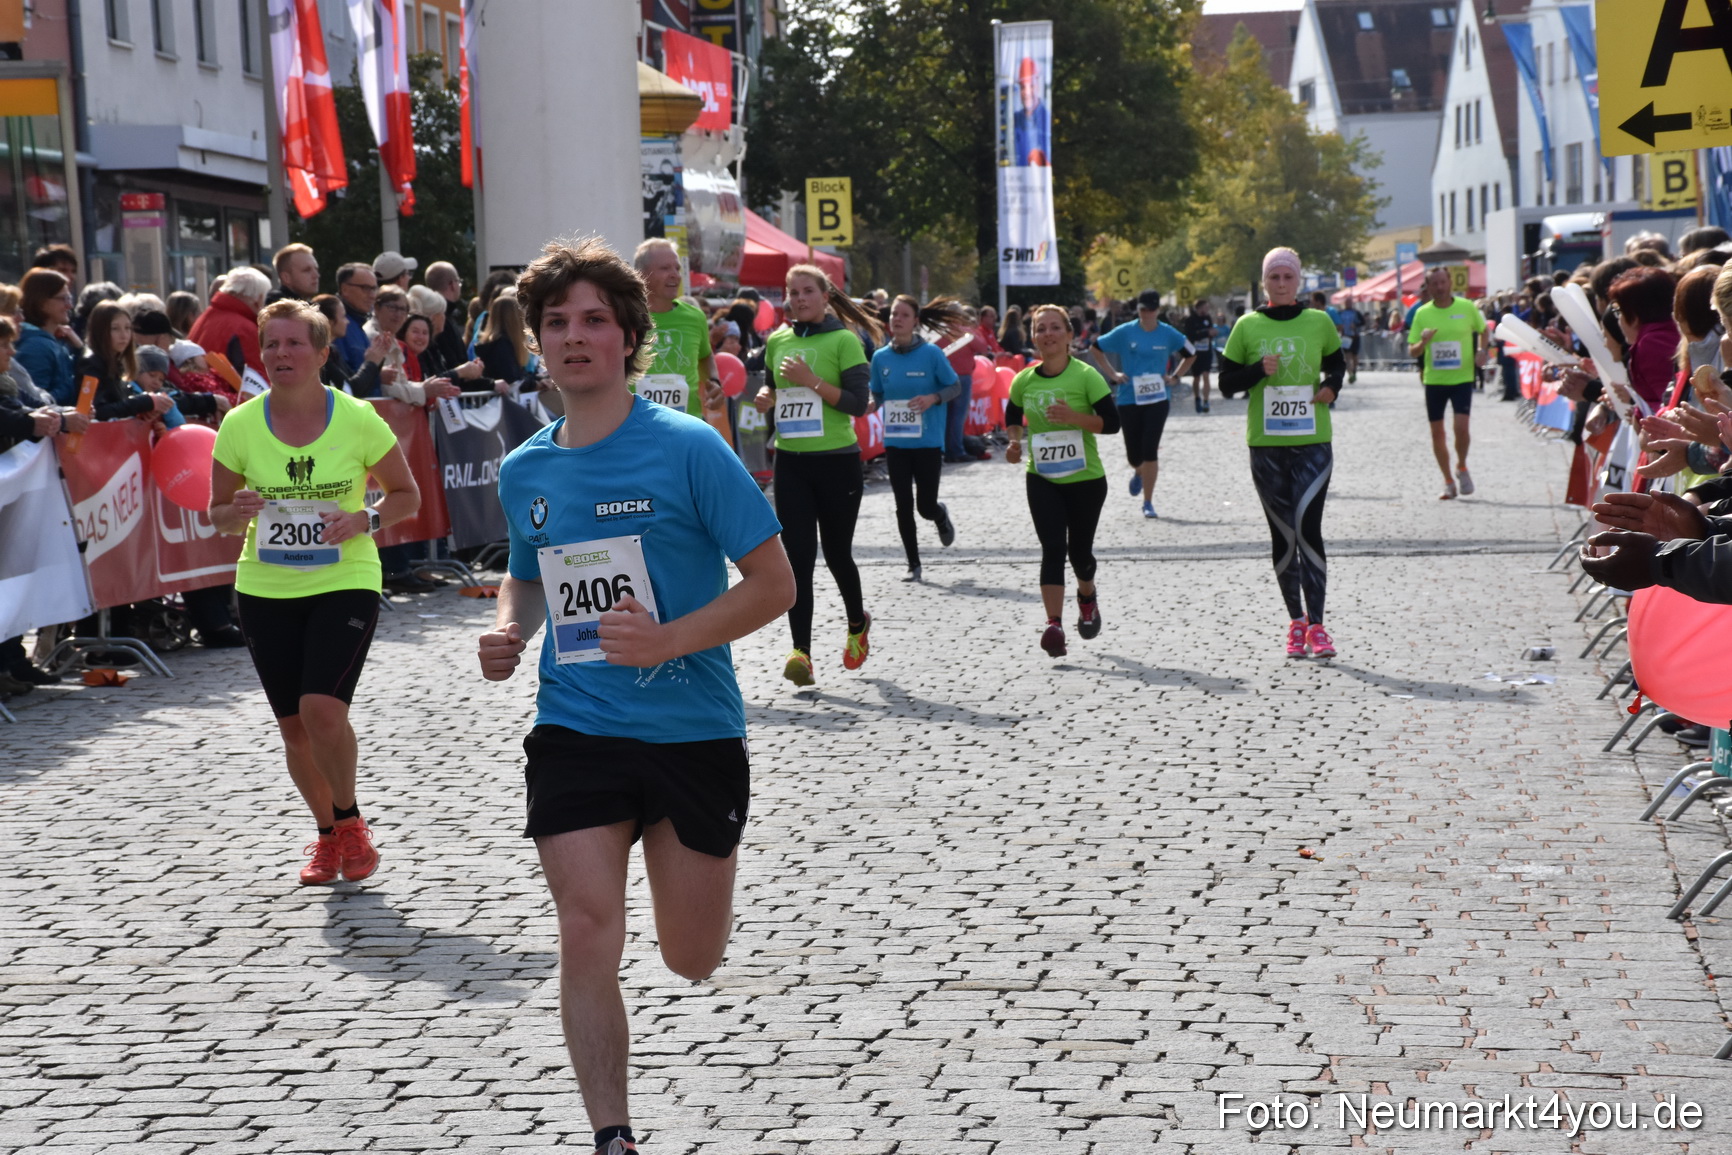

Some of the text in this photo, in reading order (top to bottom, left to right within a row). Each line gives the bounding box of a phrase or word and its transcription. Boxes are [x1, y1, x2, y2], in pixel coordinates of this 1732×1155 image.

[1663, 160, 1689, 193] B
[811, 181, 846, 193] Block
[818, 198, 841, 231] B
[1002, 247, 1034, 262] swn
[1117, 268, 1130, 287] C
[1181, 286, 1191, 299] D
[1435, 350, 1457, 359] 2304
[1138, 382, 1161, 394] 2633
[644, 390, 681, 404] 2076
[780, 402, 813, 419] 2777
[1271, 401, 1307, 416] 2075
[889, 411, 916, 423] 2138
[1040, 444, 1076, 461] 2770
[112, 471, 139, 531] NEUE
[596, 500, 651, 516] BOCK
[269, 523, 327, 546] 2308
[573, 551, 609, 564] BOCK
[560, 574, 635, 617] 2406
[576, 627, 600, 641] Joha
